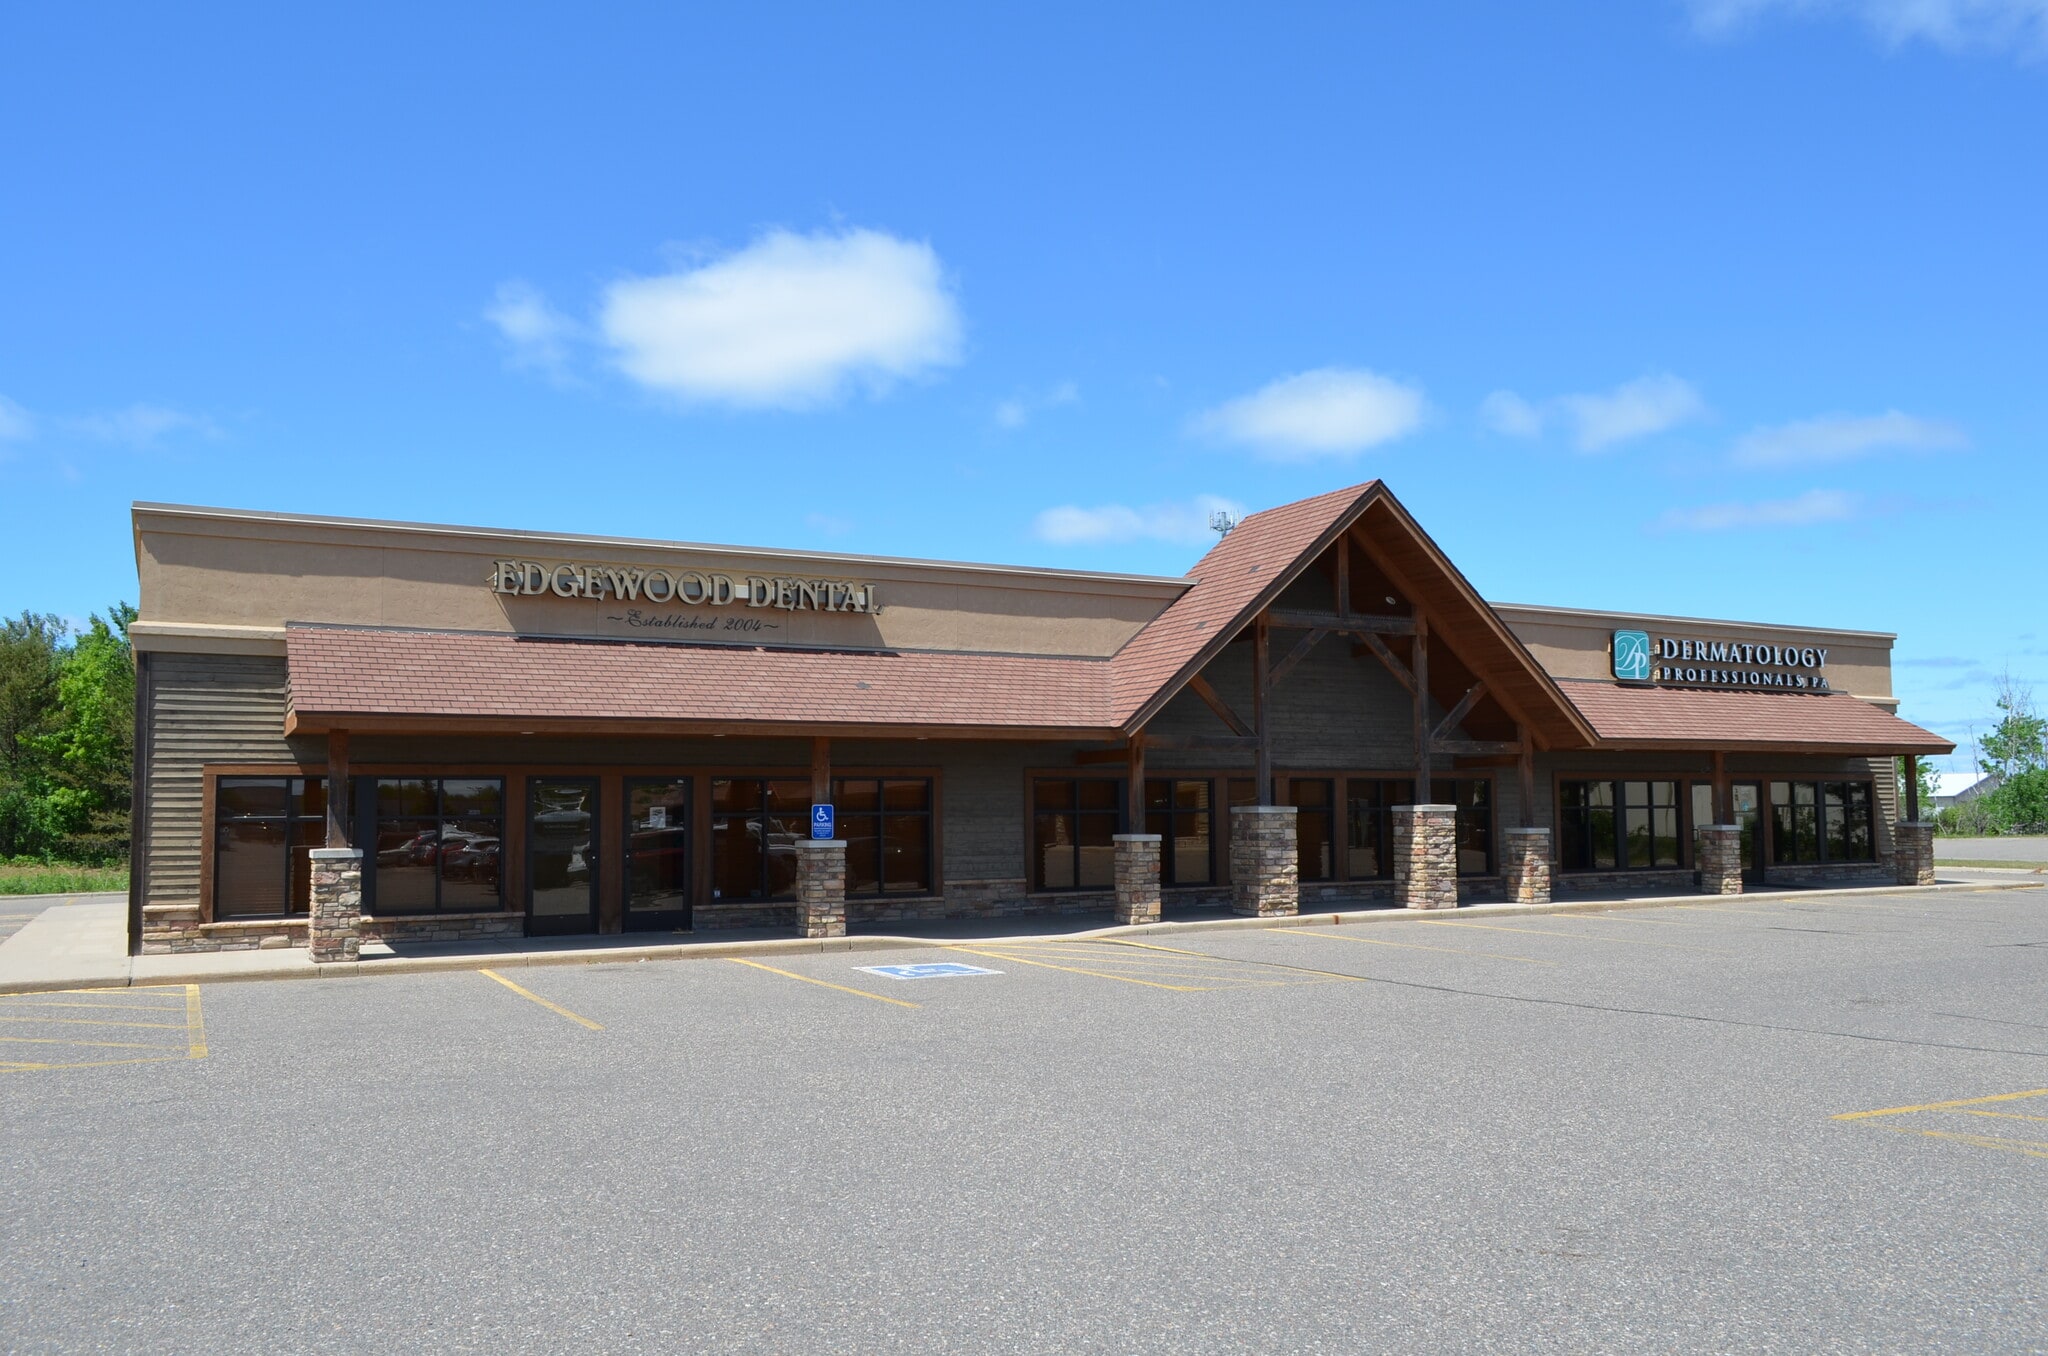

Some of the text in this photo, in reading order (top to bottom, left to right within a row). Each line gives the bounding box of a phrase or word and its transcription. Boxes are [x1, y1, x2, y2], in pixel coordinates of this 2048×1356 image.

[494, 559, 885, 615] EDGEWOOD DENTAL
[1662, 638, 1828, 668] DERMATOLOGY
[1811, 676, 1828, 689] PA
